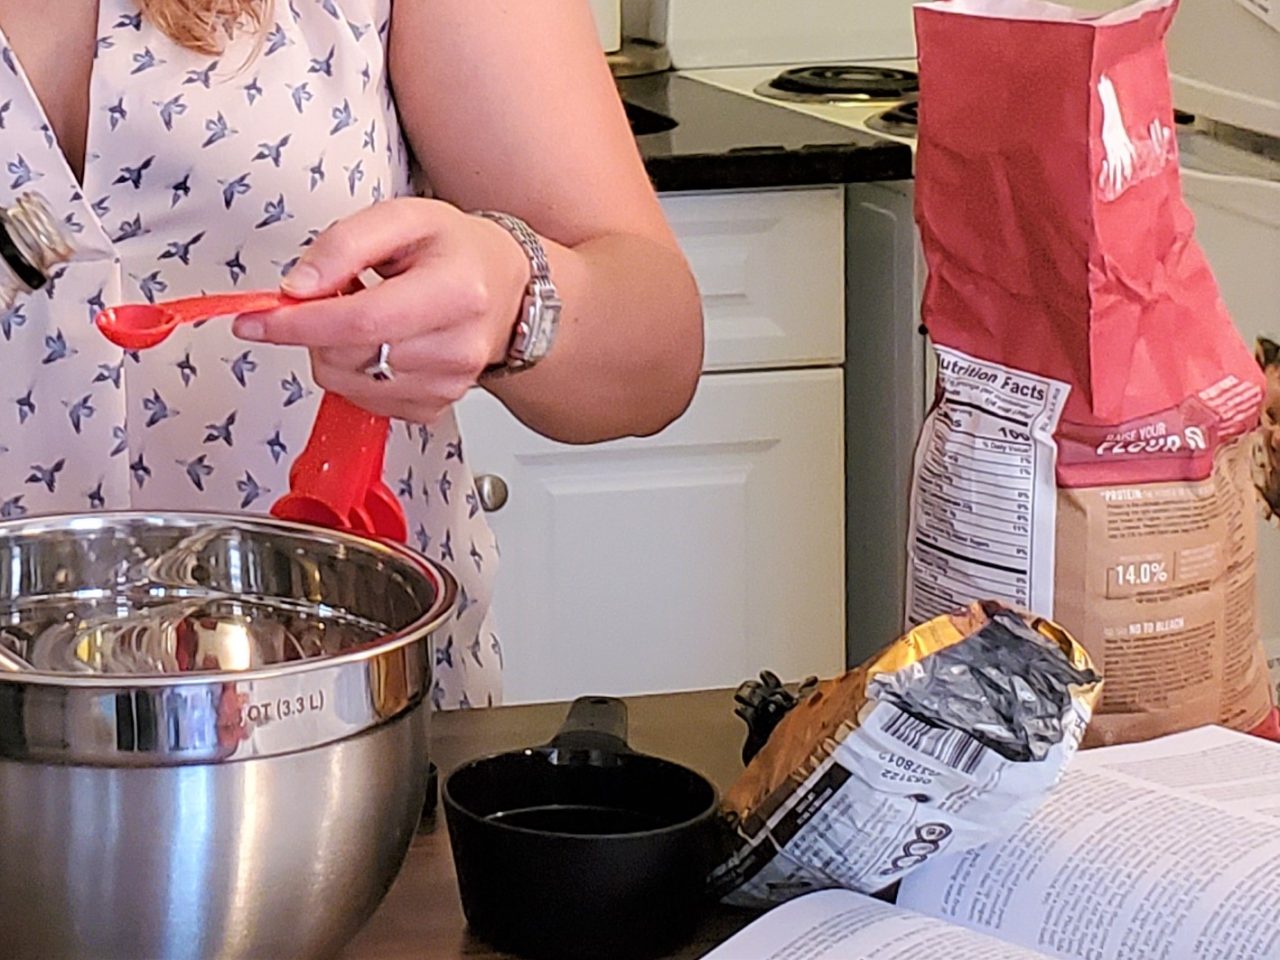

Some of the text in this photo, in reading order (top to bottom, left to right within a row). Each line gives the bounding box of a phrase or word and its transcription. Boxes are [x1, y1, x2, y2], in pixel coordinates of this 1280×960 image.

[1001, 376, 1045, 401] Facts
[1139, 422, 1166, 440] YOUR
[1116, 562, 1168, 585] 14.0%
[247, 703, 272, 722] QT
[276, 696, 305, 721] (3.3
[310, 690, 325, 711] L)
